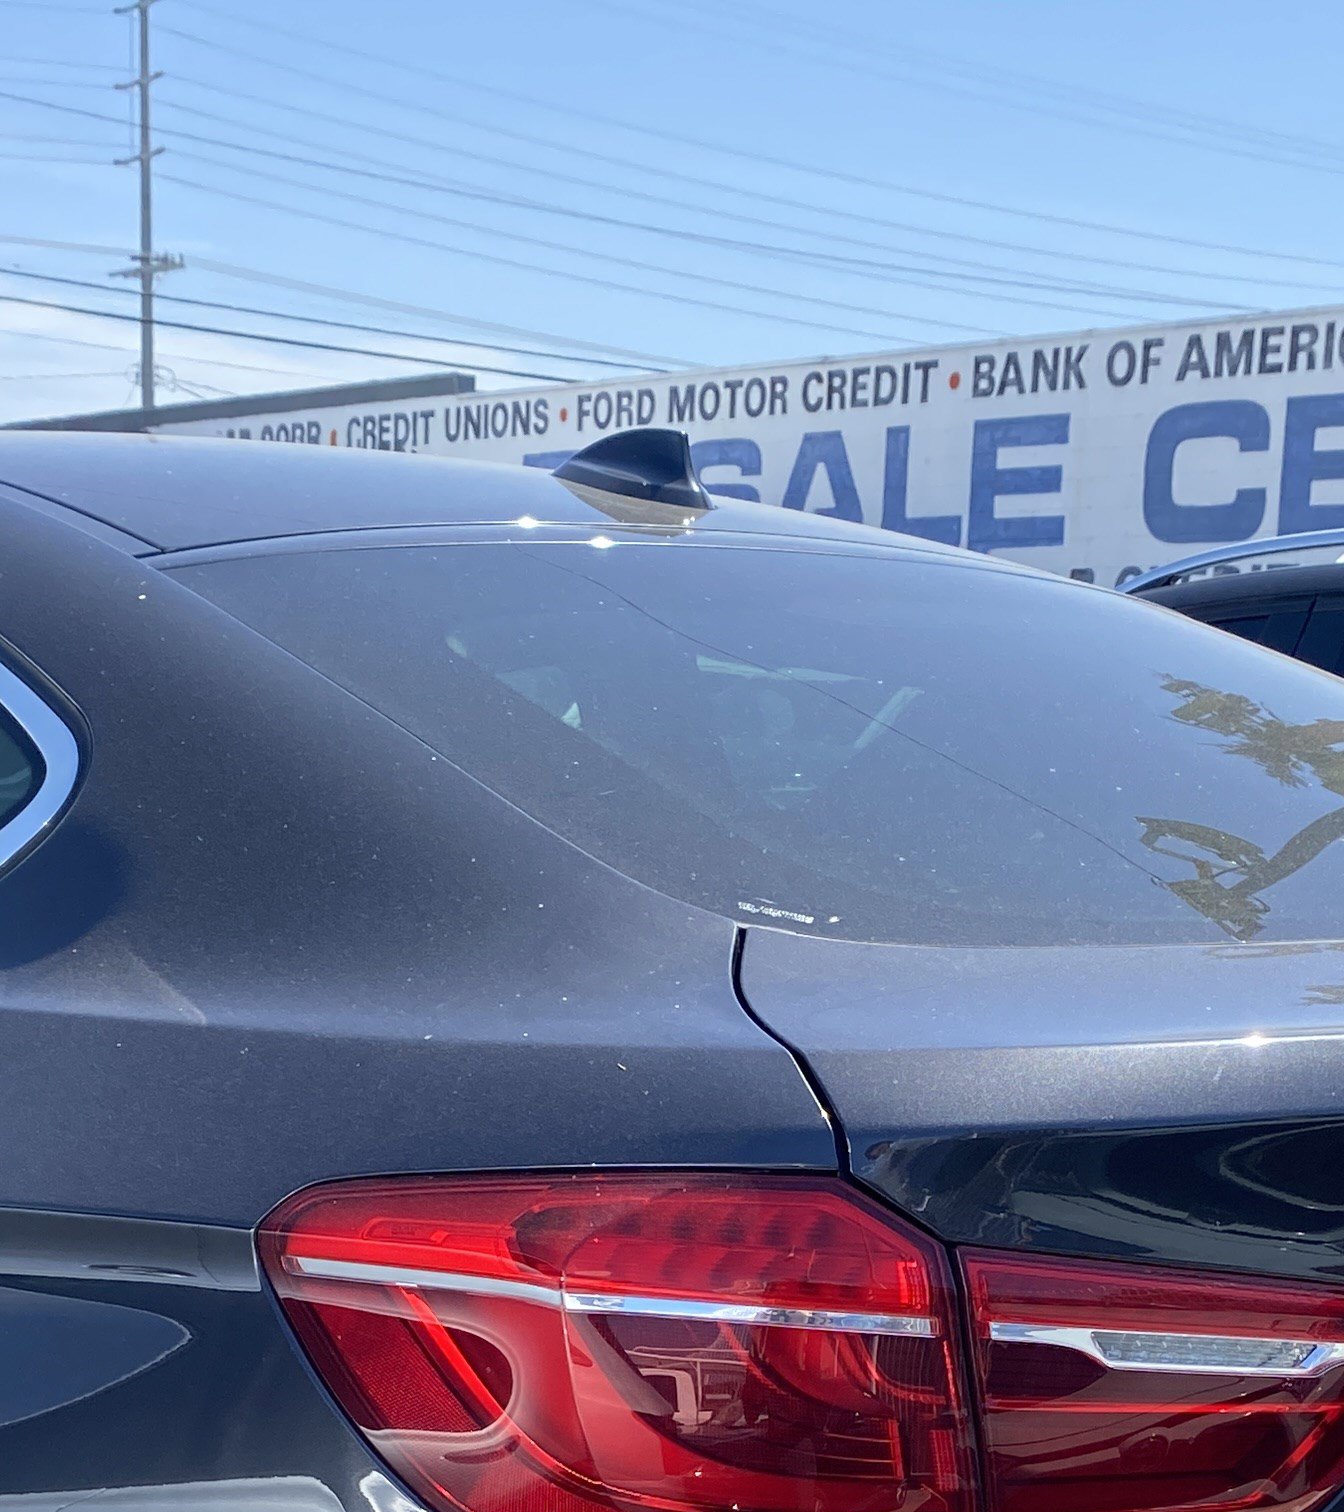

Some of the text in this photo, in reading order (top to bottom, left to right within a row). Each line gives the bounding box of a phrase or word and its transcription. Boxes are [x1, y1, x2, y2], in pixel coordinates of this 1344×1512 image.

[347, 410, 434, 453] CREDIT
[444, 399, 549, 443] UNIONS
[577, 388, 655, 431] FORD
[668, 375, 788, 424] MOTOR
[802, 359, 939, 413] CREDIT
[972, 343, 1090, 398] BANK
[1106, 337, 1165, 387] OF
[690, 413, 1071, 553] SALE
